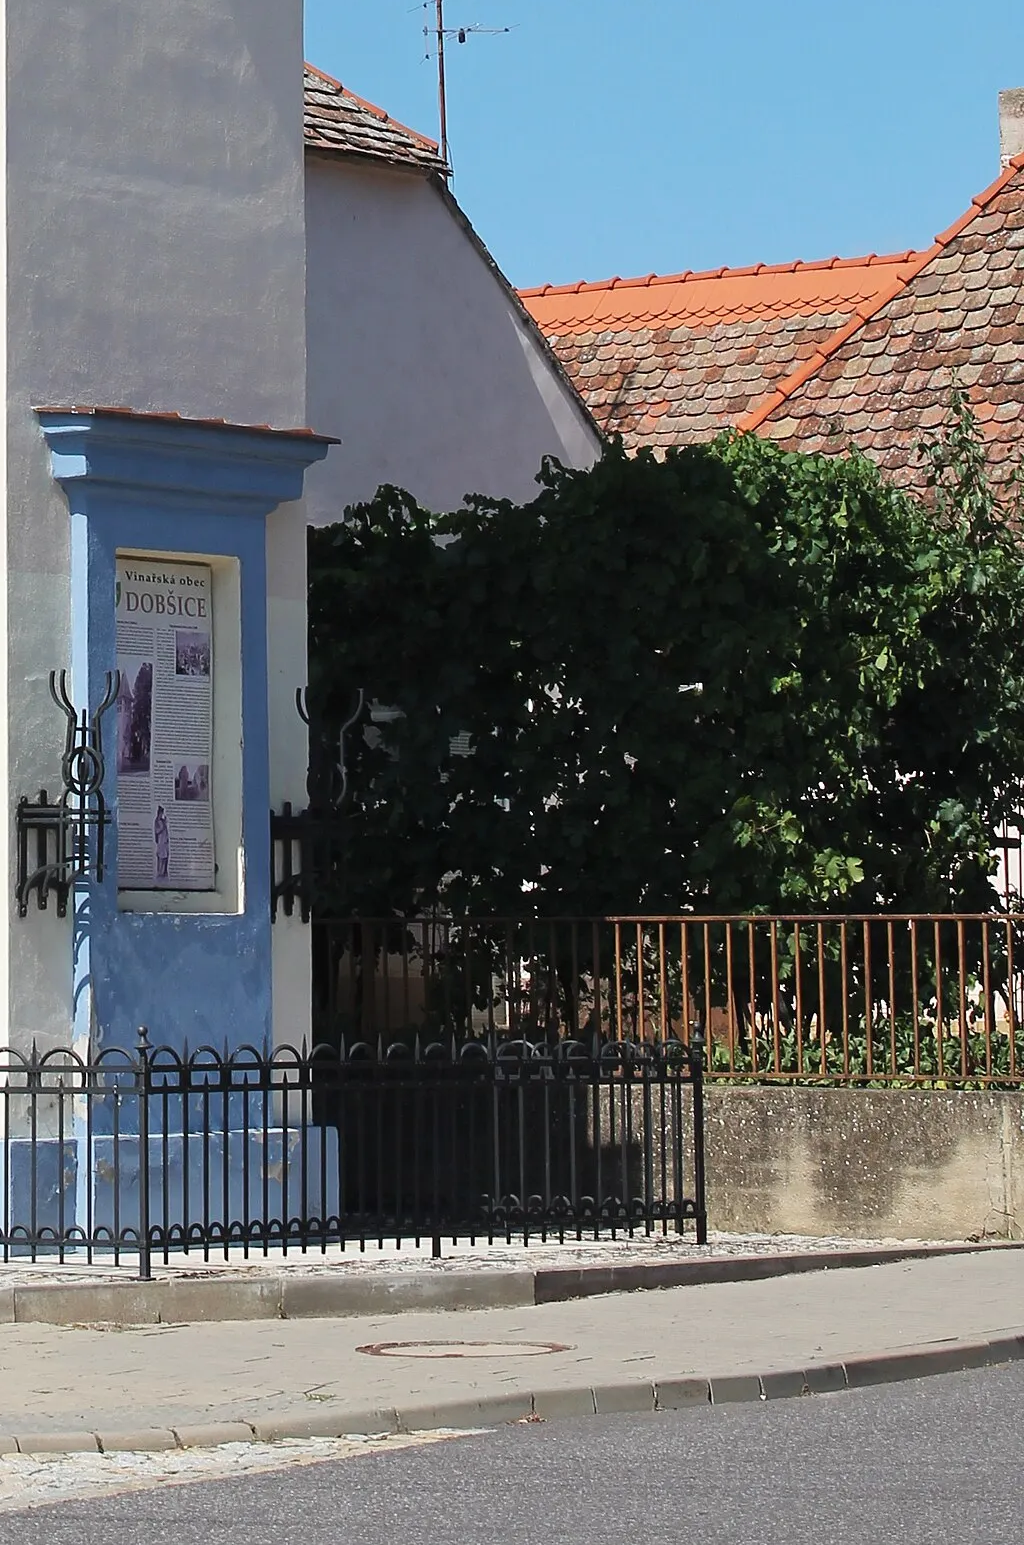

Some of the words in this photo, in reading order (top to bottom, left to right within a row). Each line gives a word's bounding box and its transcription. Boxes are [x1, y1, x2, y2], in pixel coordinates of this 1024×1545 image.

[125, 570, 176, 585] Vinařská
[179, 576, 205, 588] obec
[125, 589, 207, 618] DOBŠICE
